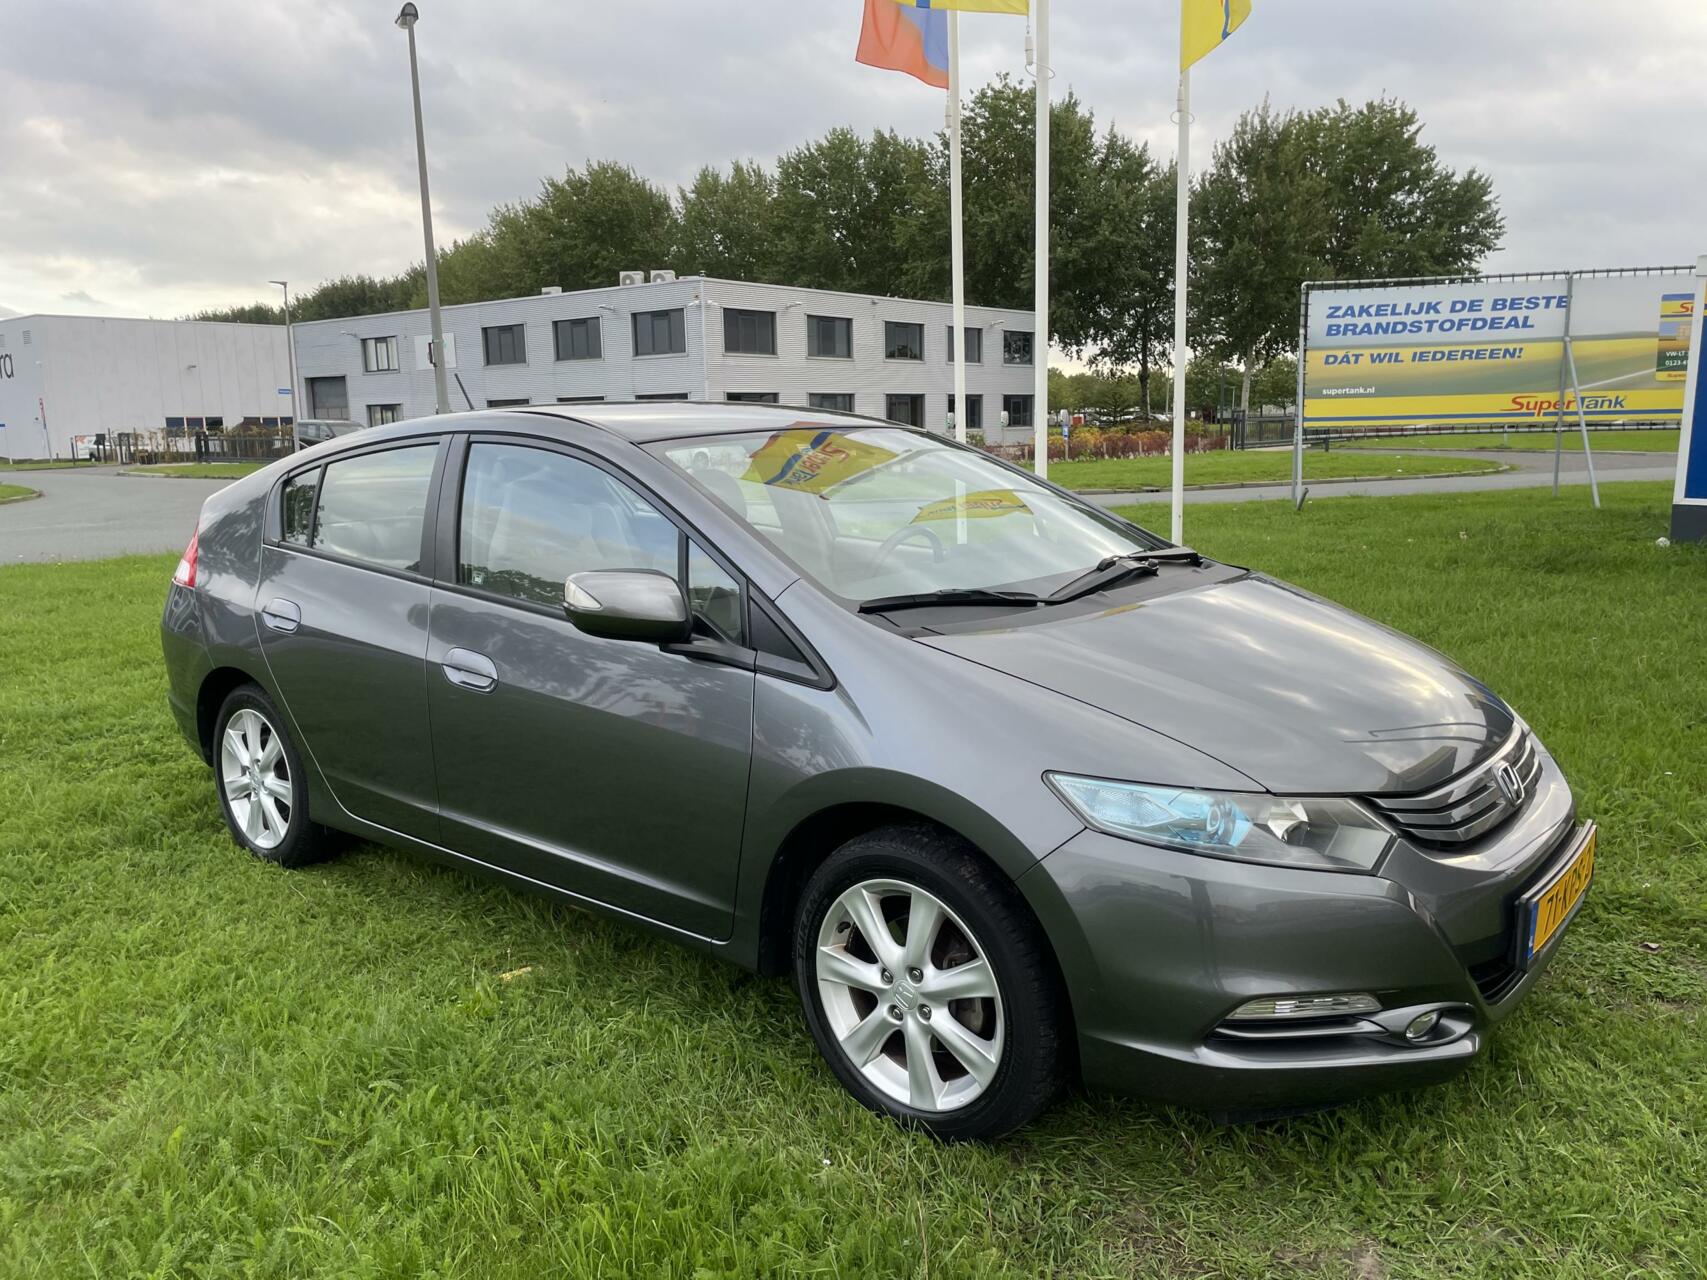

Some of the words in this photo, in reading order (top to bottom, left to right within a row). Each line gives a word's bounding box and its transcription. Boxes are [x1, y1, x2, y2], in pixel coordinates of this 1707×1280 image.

[1326, 301, 1442, 319] ZAKELIJK
[1449, 299, 1484, 313] DE
[1491, 296, 1569, 311] BESTE
[1326, 315, 1534, 336] BRANDSTOFDEAL
[1324, 351, 1364, 365] DÁT
[1369, 352, 1404, 364] WIL
[1411, 347, 1523, 362] IEDEREEN!
[1322, 386, 1376, 396] supertank.nl
[1500, 396, 1626, 417] SuperTank
